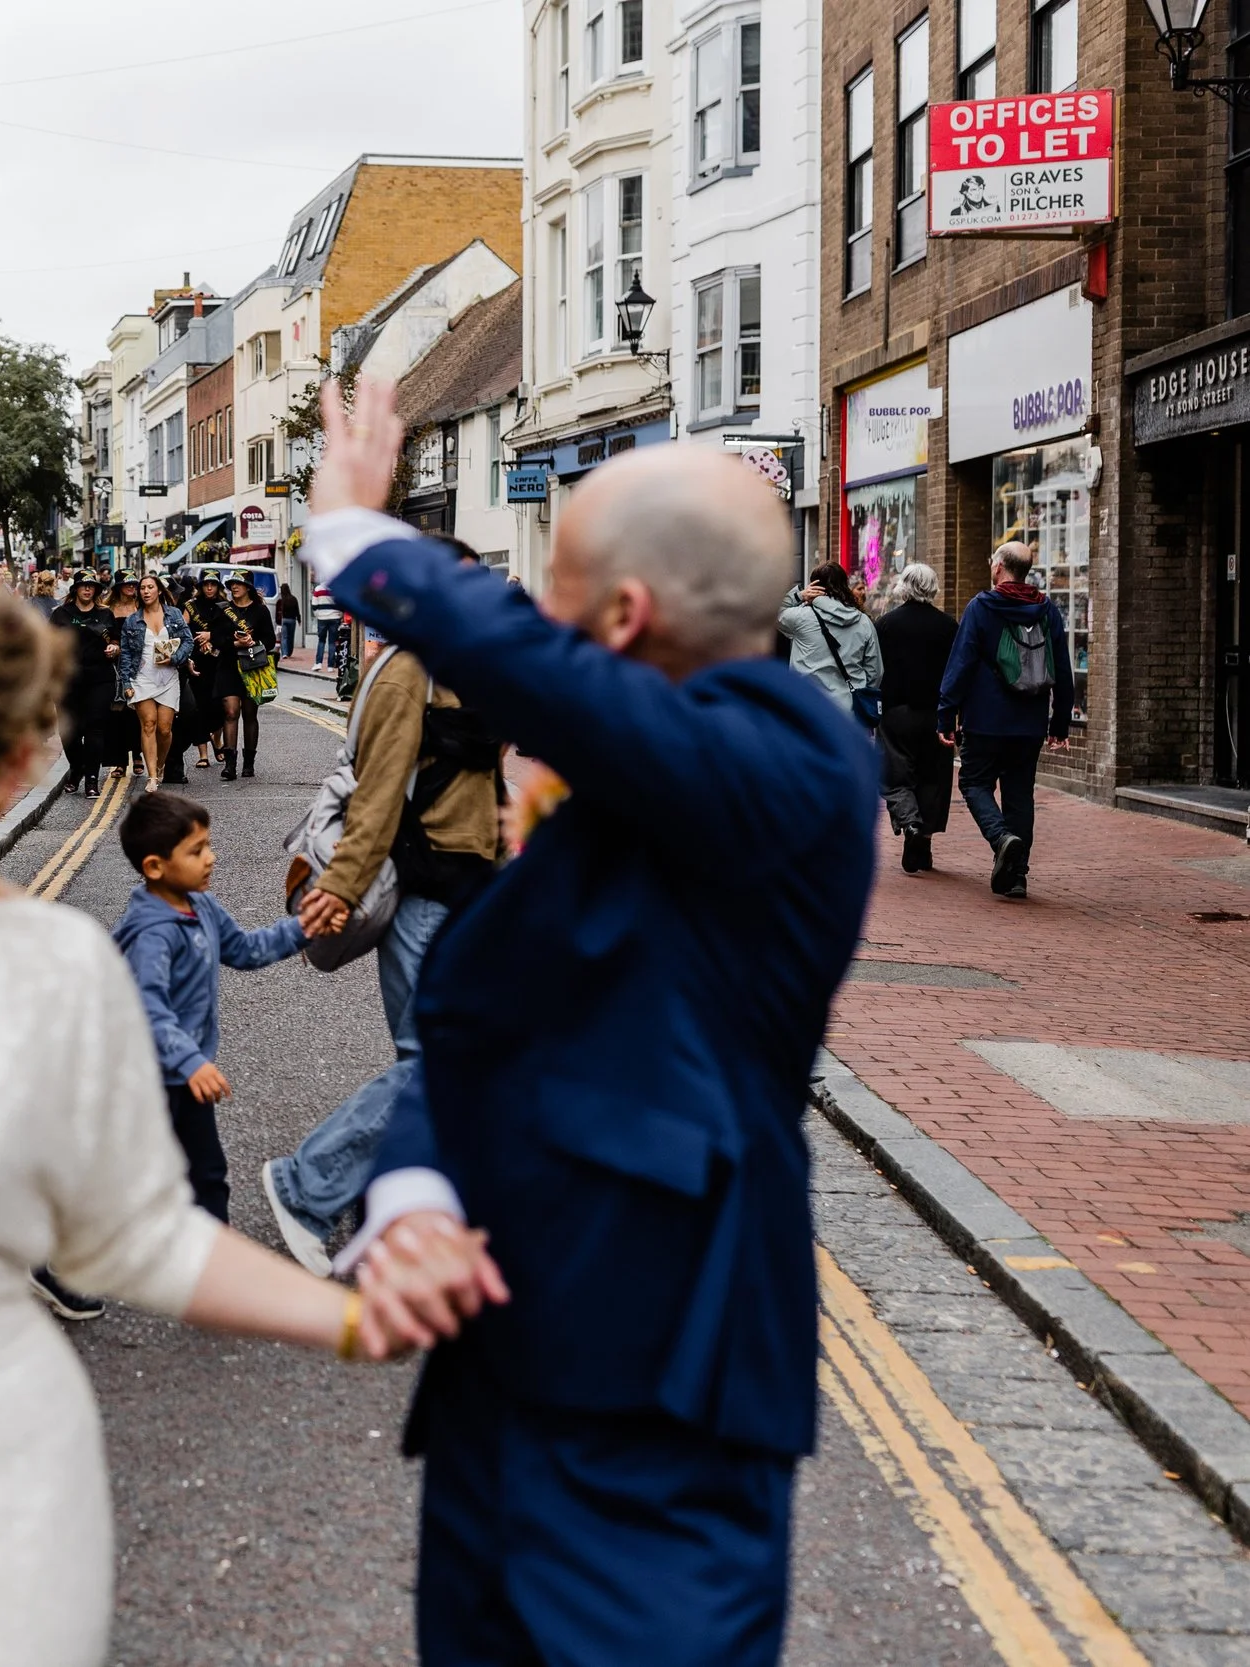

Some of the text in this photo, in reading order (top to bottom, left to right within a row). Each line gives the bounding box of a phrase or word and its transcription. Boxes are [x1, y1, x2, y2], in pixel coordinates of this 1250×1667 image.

[950, 95, 1099, 132] OFFICES
[952, 126, 1096, 165] TO LET
[1010, 168, 1083, 186] GRAVES
[1010, 187, 1041, 196] SON &
[1010, 193, 1084, 212] PILCHER
[1010, 209, 1085, 221] 01273 321 123
[1150, 347, 1248, 403] EDGE HOUSE
[1013, 386, 1054, 430] BUBBLE
[1166, 386, 1232, 418] 42 BOND STREET
[869, 407, 907, 417] BUBBLE
[509, 483, 545, 493] NERO
[242, 512, 263, 520] COSTA
